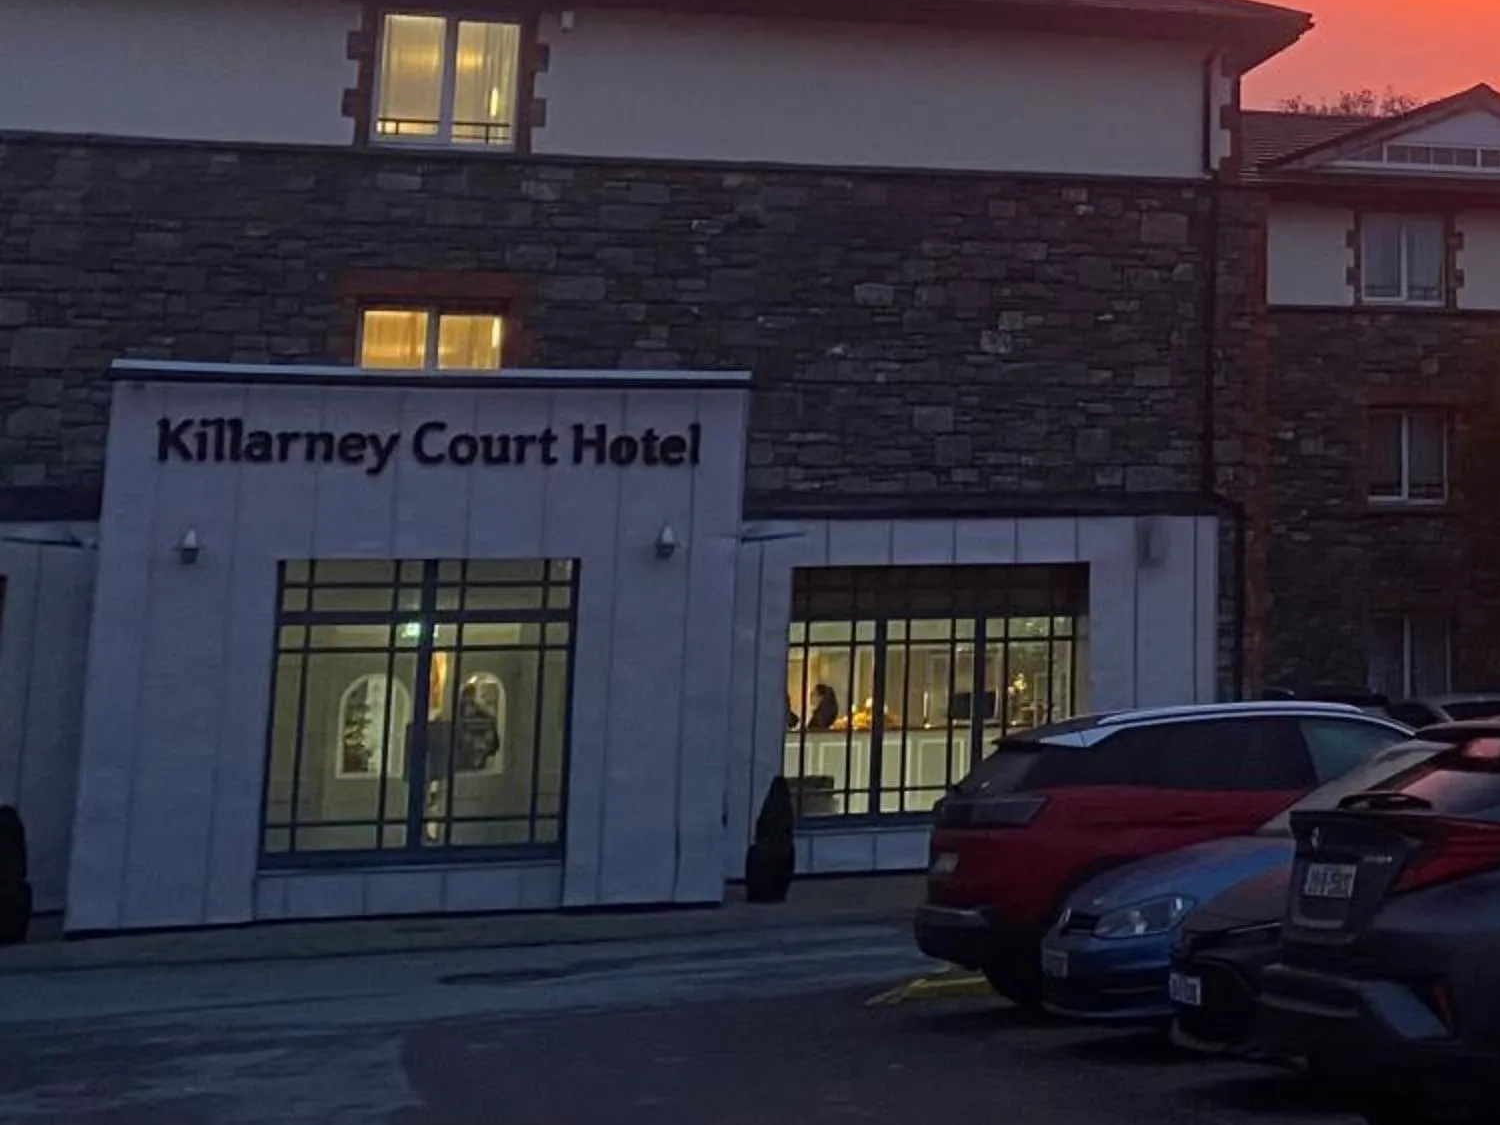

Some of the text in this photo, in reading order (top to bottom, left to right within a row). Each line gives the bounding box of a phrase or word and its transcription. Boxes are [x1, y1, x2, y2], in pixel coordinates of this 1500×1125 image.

[156, 416, 702, 476] Killarney Court Hotel
